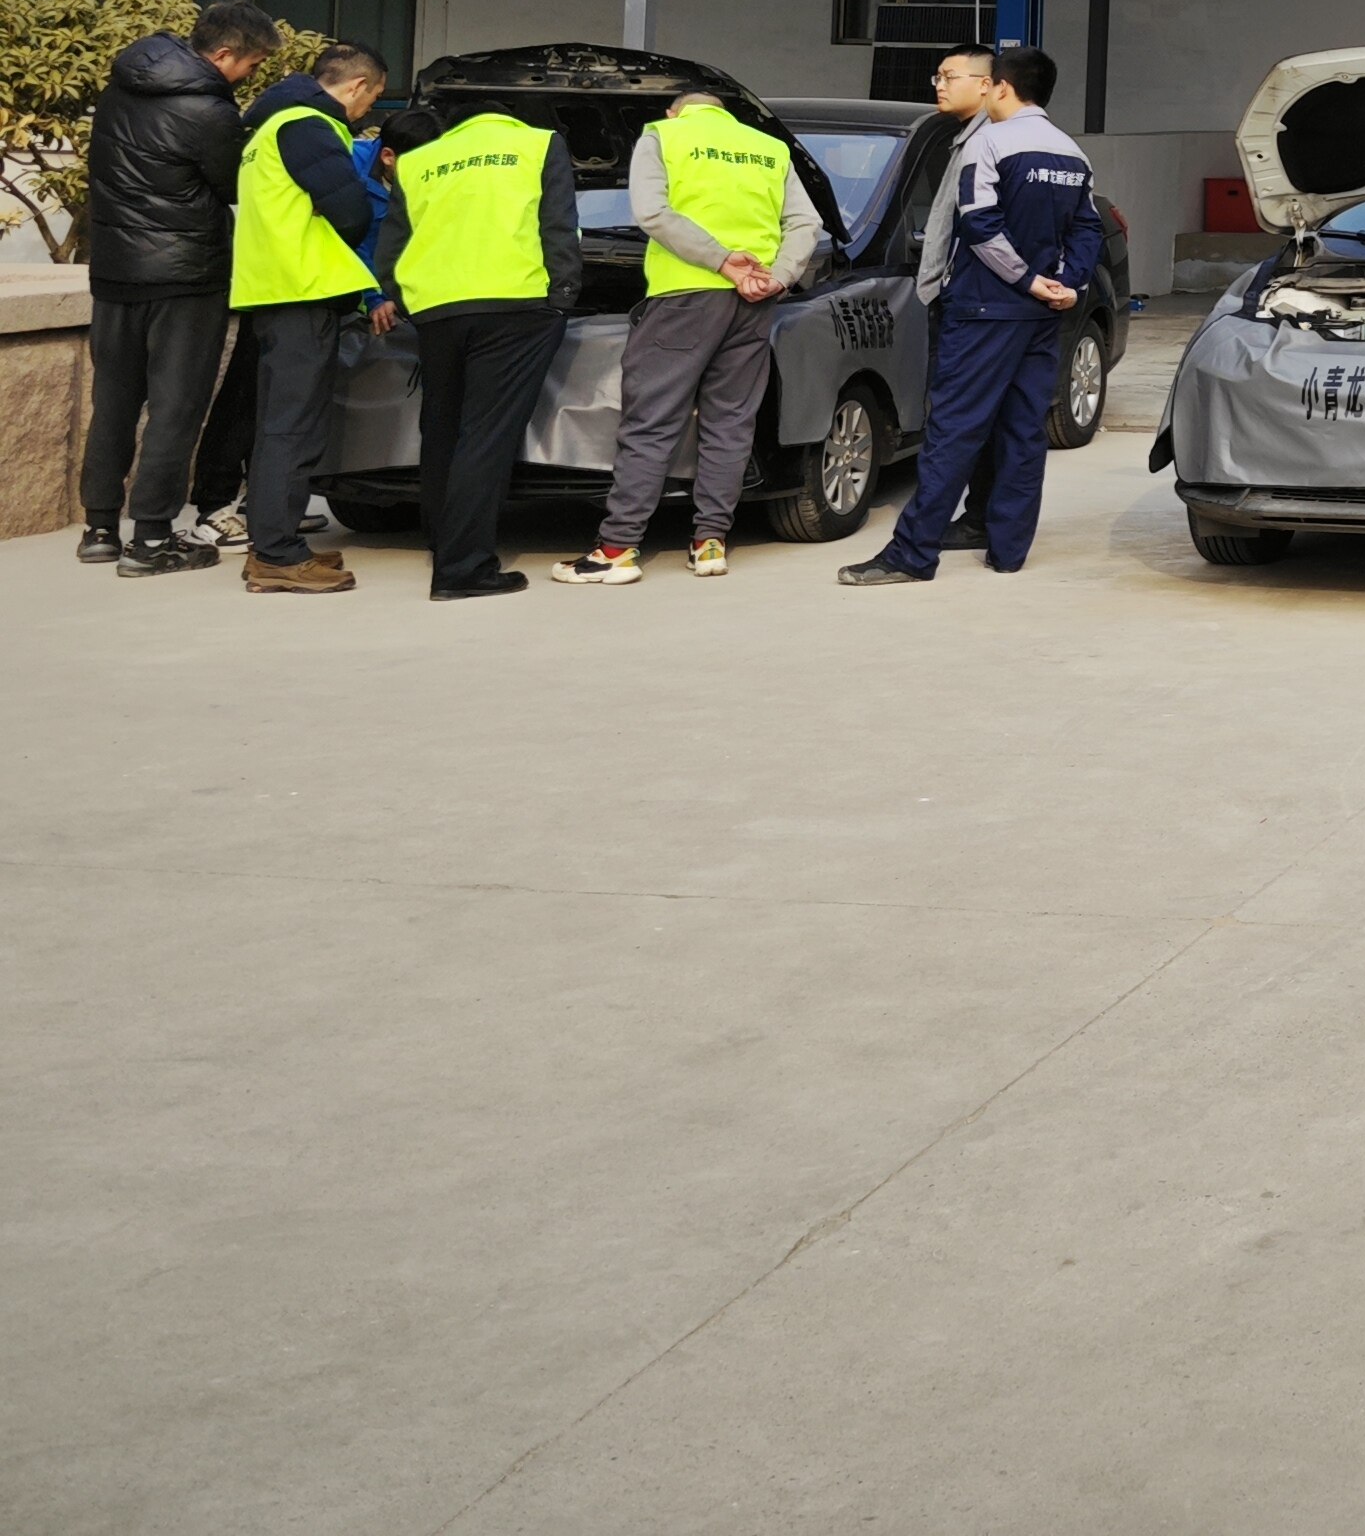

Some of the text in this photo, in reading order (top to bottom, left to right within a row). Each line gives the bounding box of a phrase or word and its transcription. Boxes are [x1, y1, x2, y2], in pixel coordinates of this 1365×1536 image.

[421, 153, 519, 182] 小青龙新能源
[690, 147, 776, 169] 小青龙新能源
